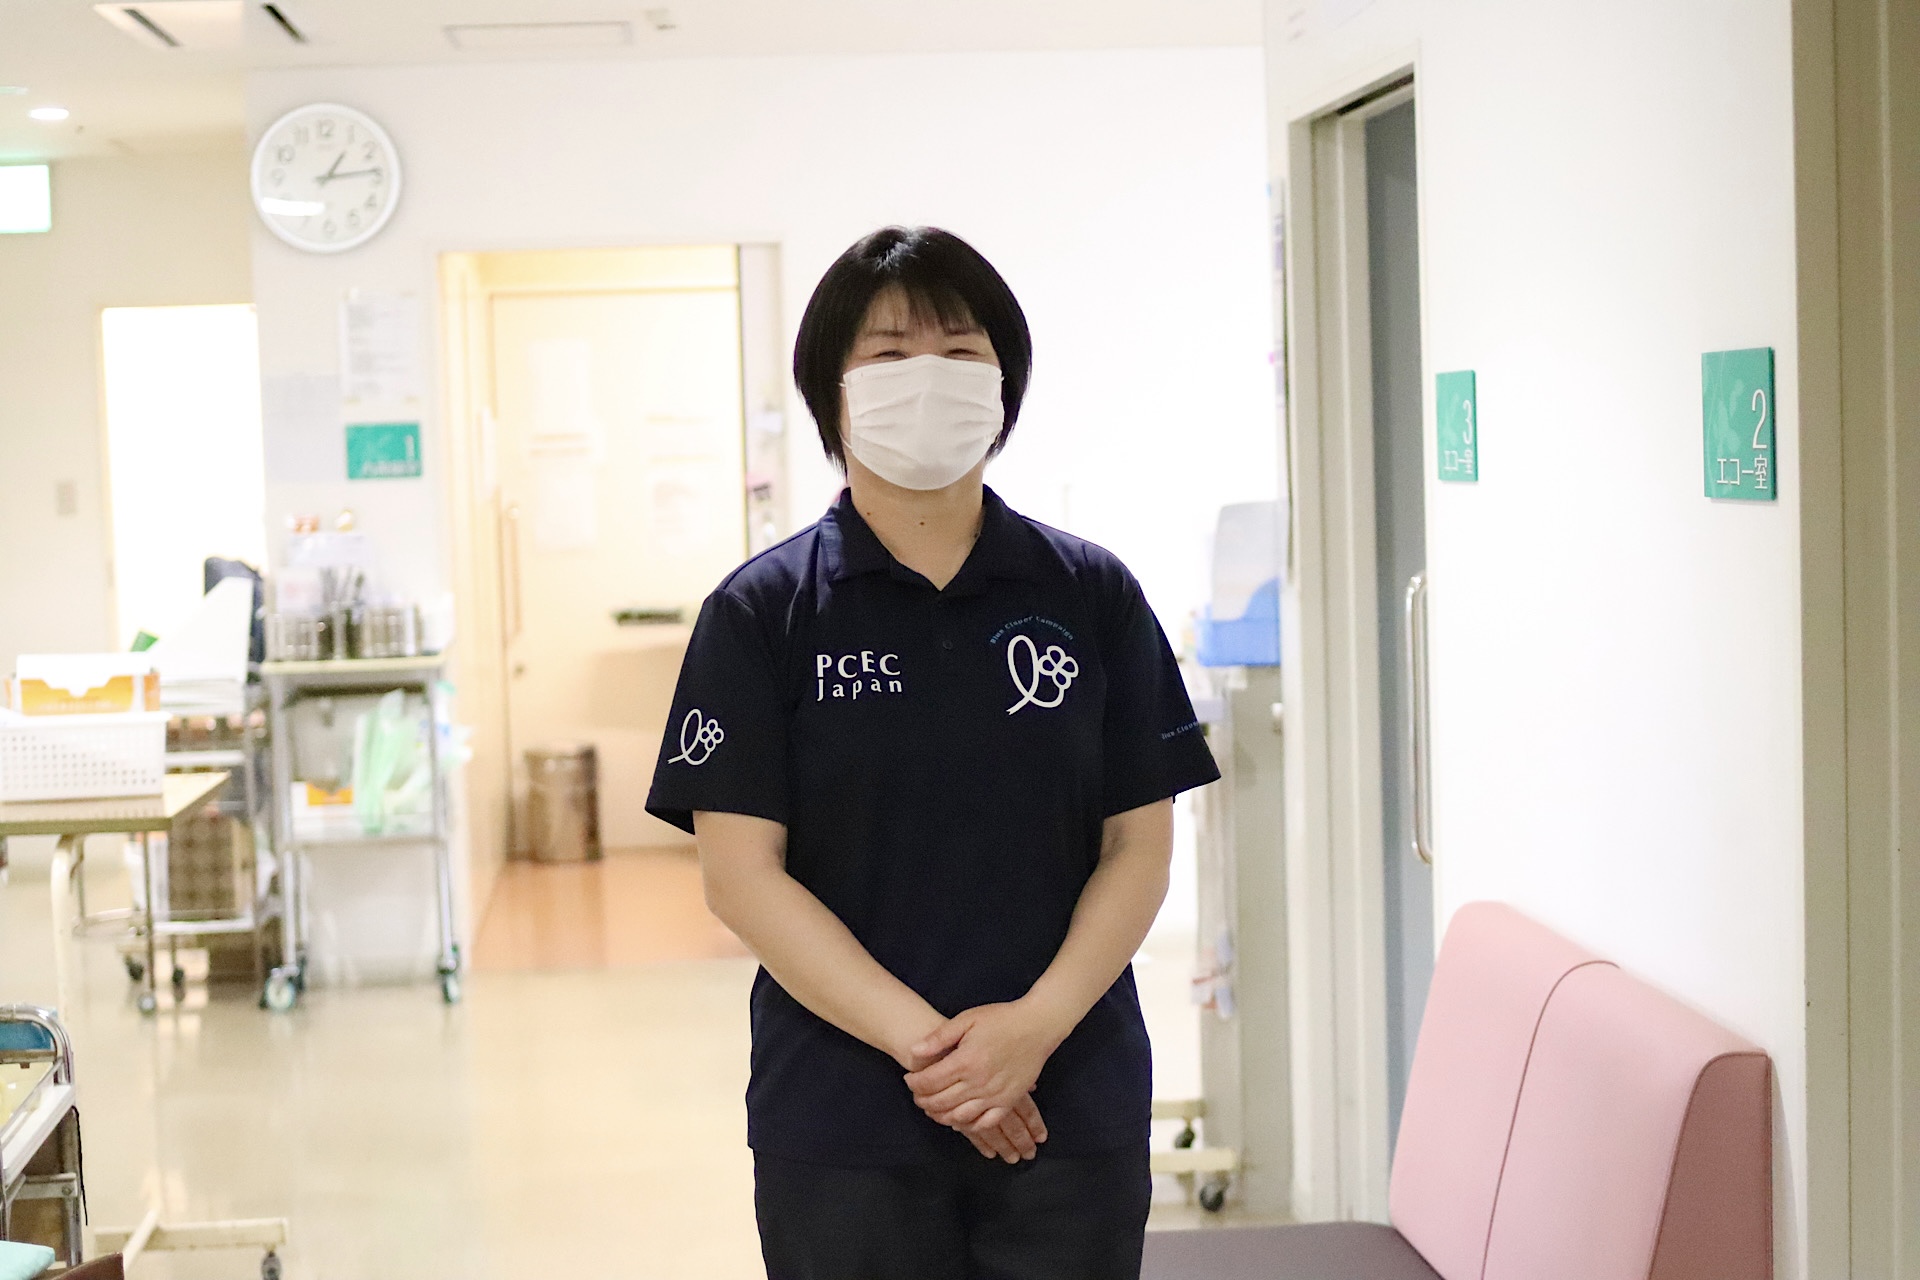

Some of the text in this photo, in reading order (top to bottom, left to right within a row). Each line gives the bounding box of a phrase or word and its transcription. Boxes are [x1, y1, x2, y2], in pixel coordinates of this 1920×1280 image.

[317, 119, 335, 137] 12
[277, 144, 295, 163] 10
[363, 141, 376, 161] 2
[365, 194, 377, 207] 4
[323, 219, 336, 238] 6
[1462, 399, 1473, 445] 3
[1752, 389, 1767, 449] 2
[1716, 453, 1768, 490] エコー室
[990, 629, 1005, 644] Blue
[1004, 615, 1034, 630] Clover
[816, 650, 901, 679] PCEC
[816, 678, 903, 702] Japan
